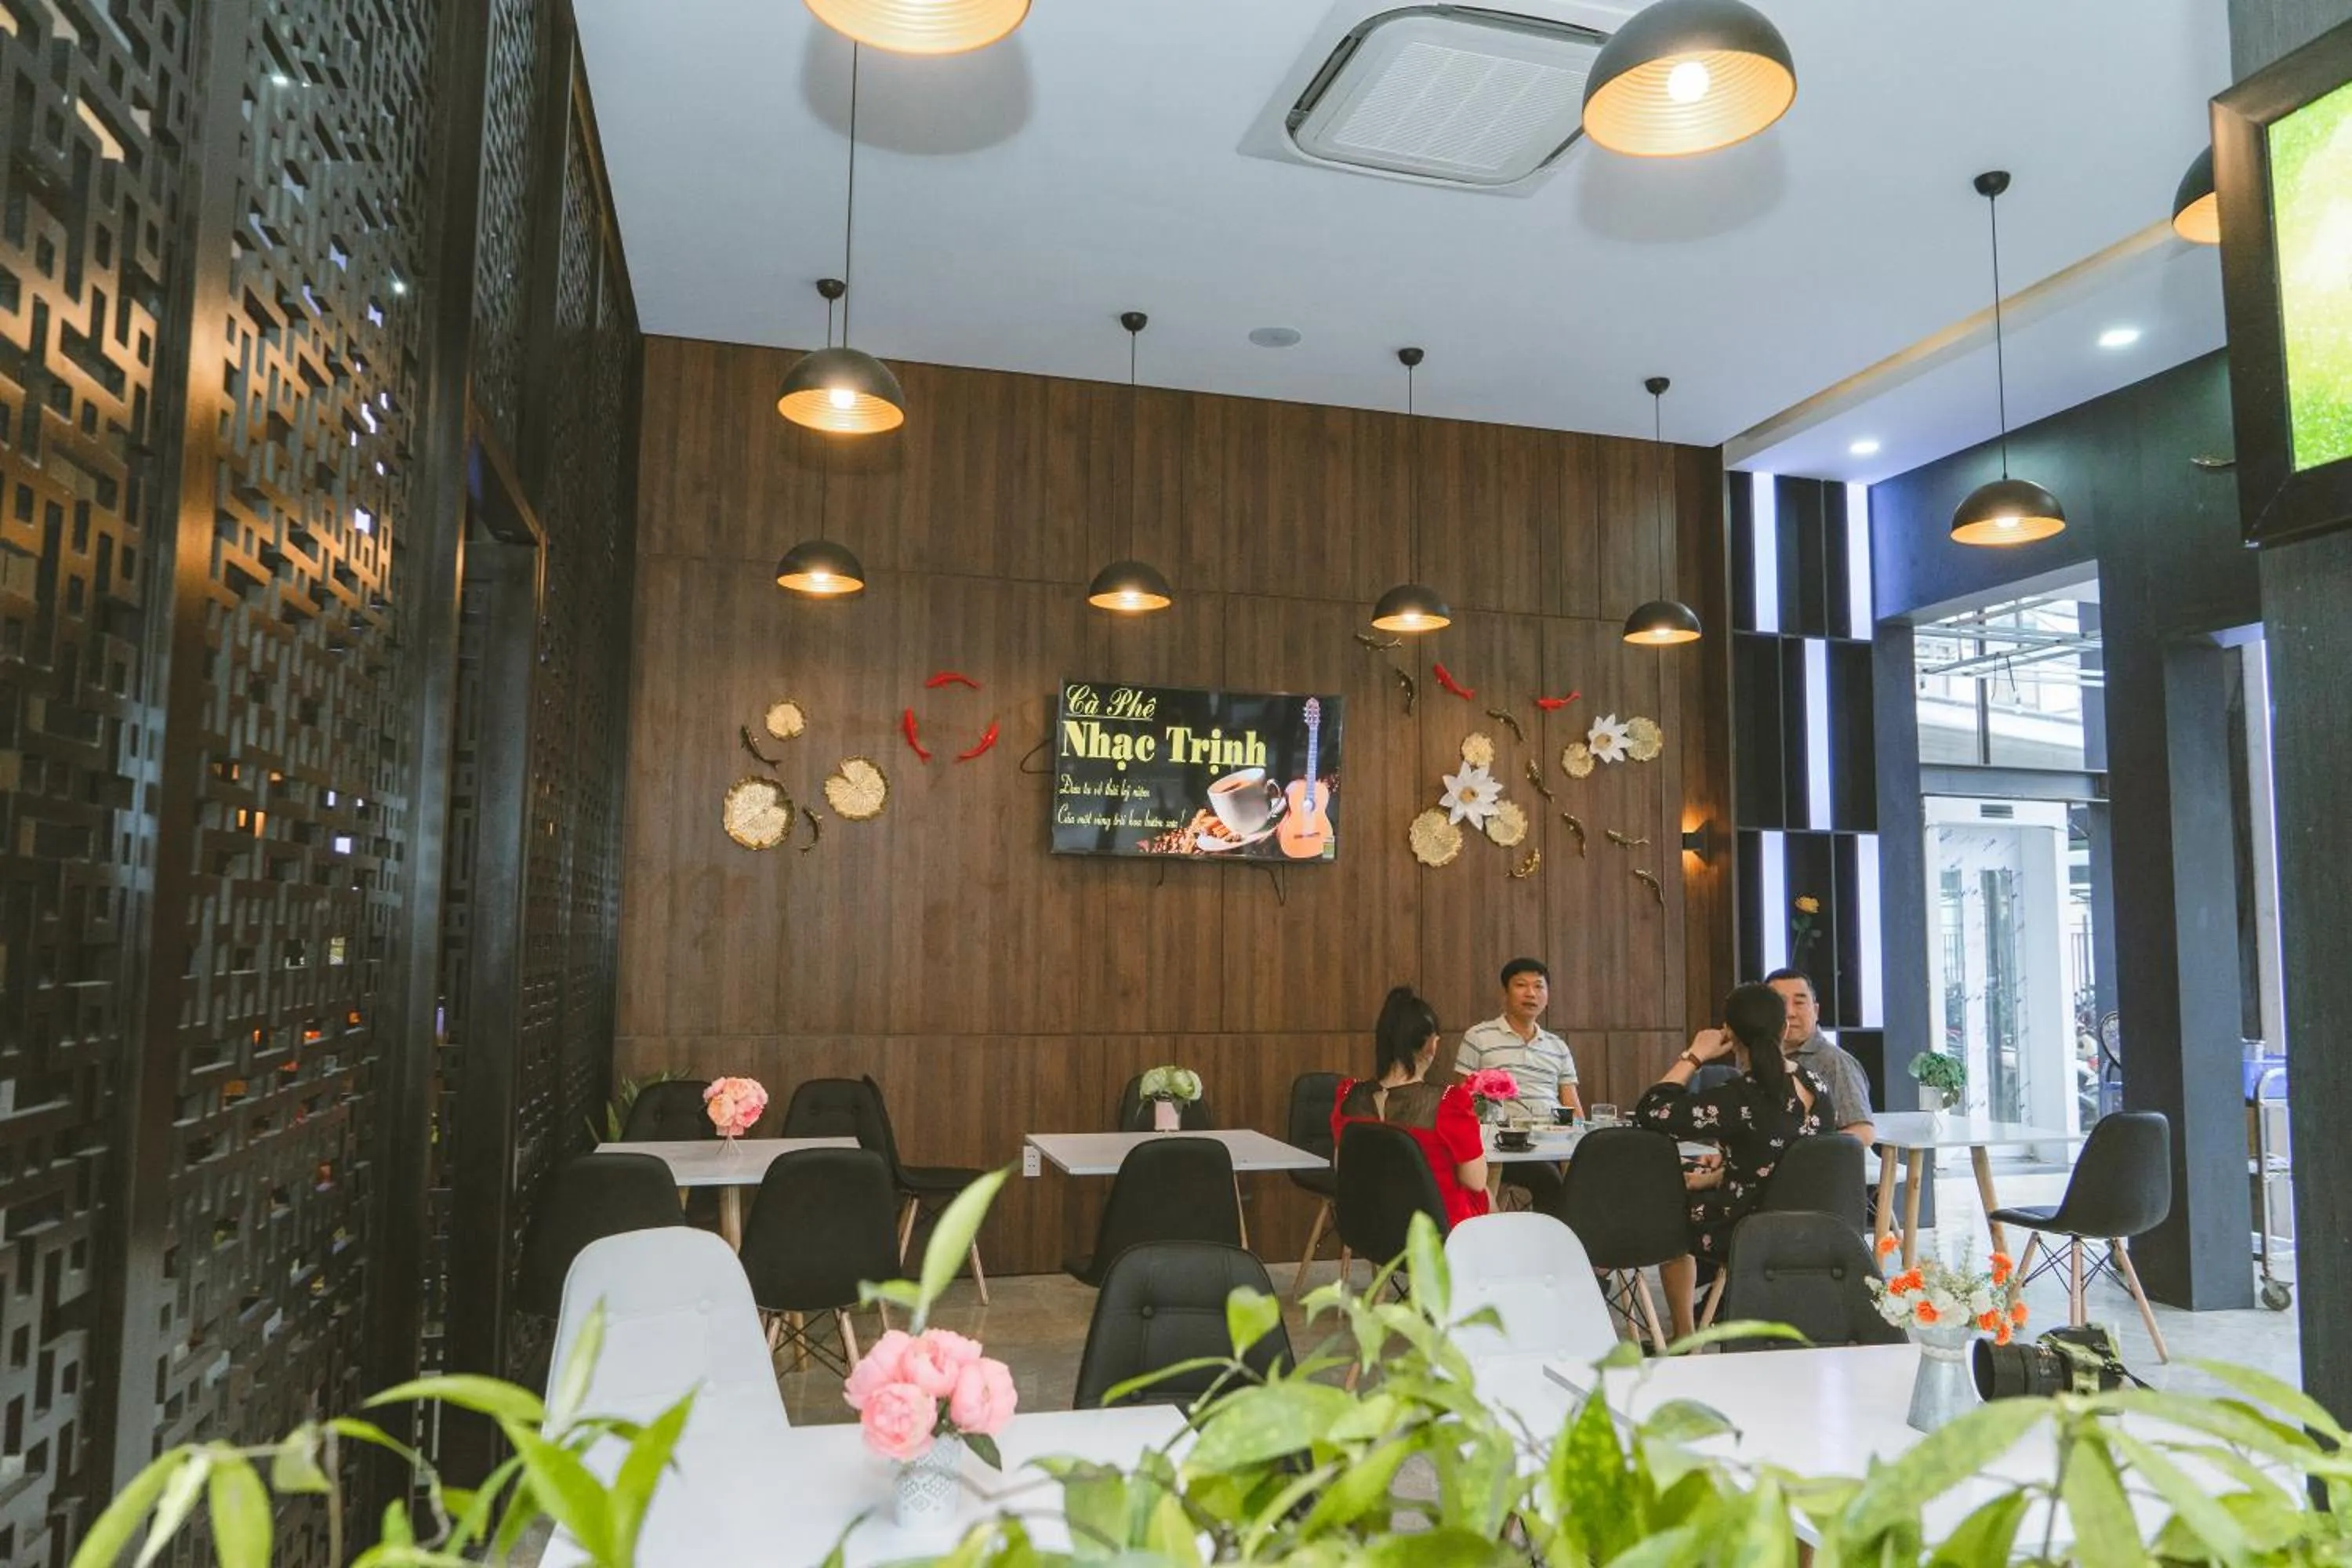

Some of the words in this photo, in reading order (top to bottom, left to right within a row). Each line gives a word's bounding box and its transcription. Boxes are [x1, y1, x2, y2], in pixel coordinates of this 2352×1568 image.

[1066, 684, 1099, 715] Cà
[1107, 688, 1156, 718] Phê
[1061, 720, 1156, 771] Nhạc
[1166, 727, 1266, 775] Trịnh
